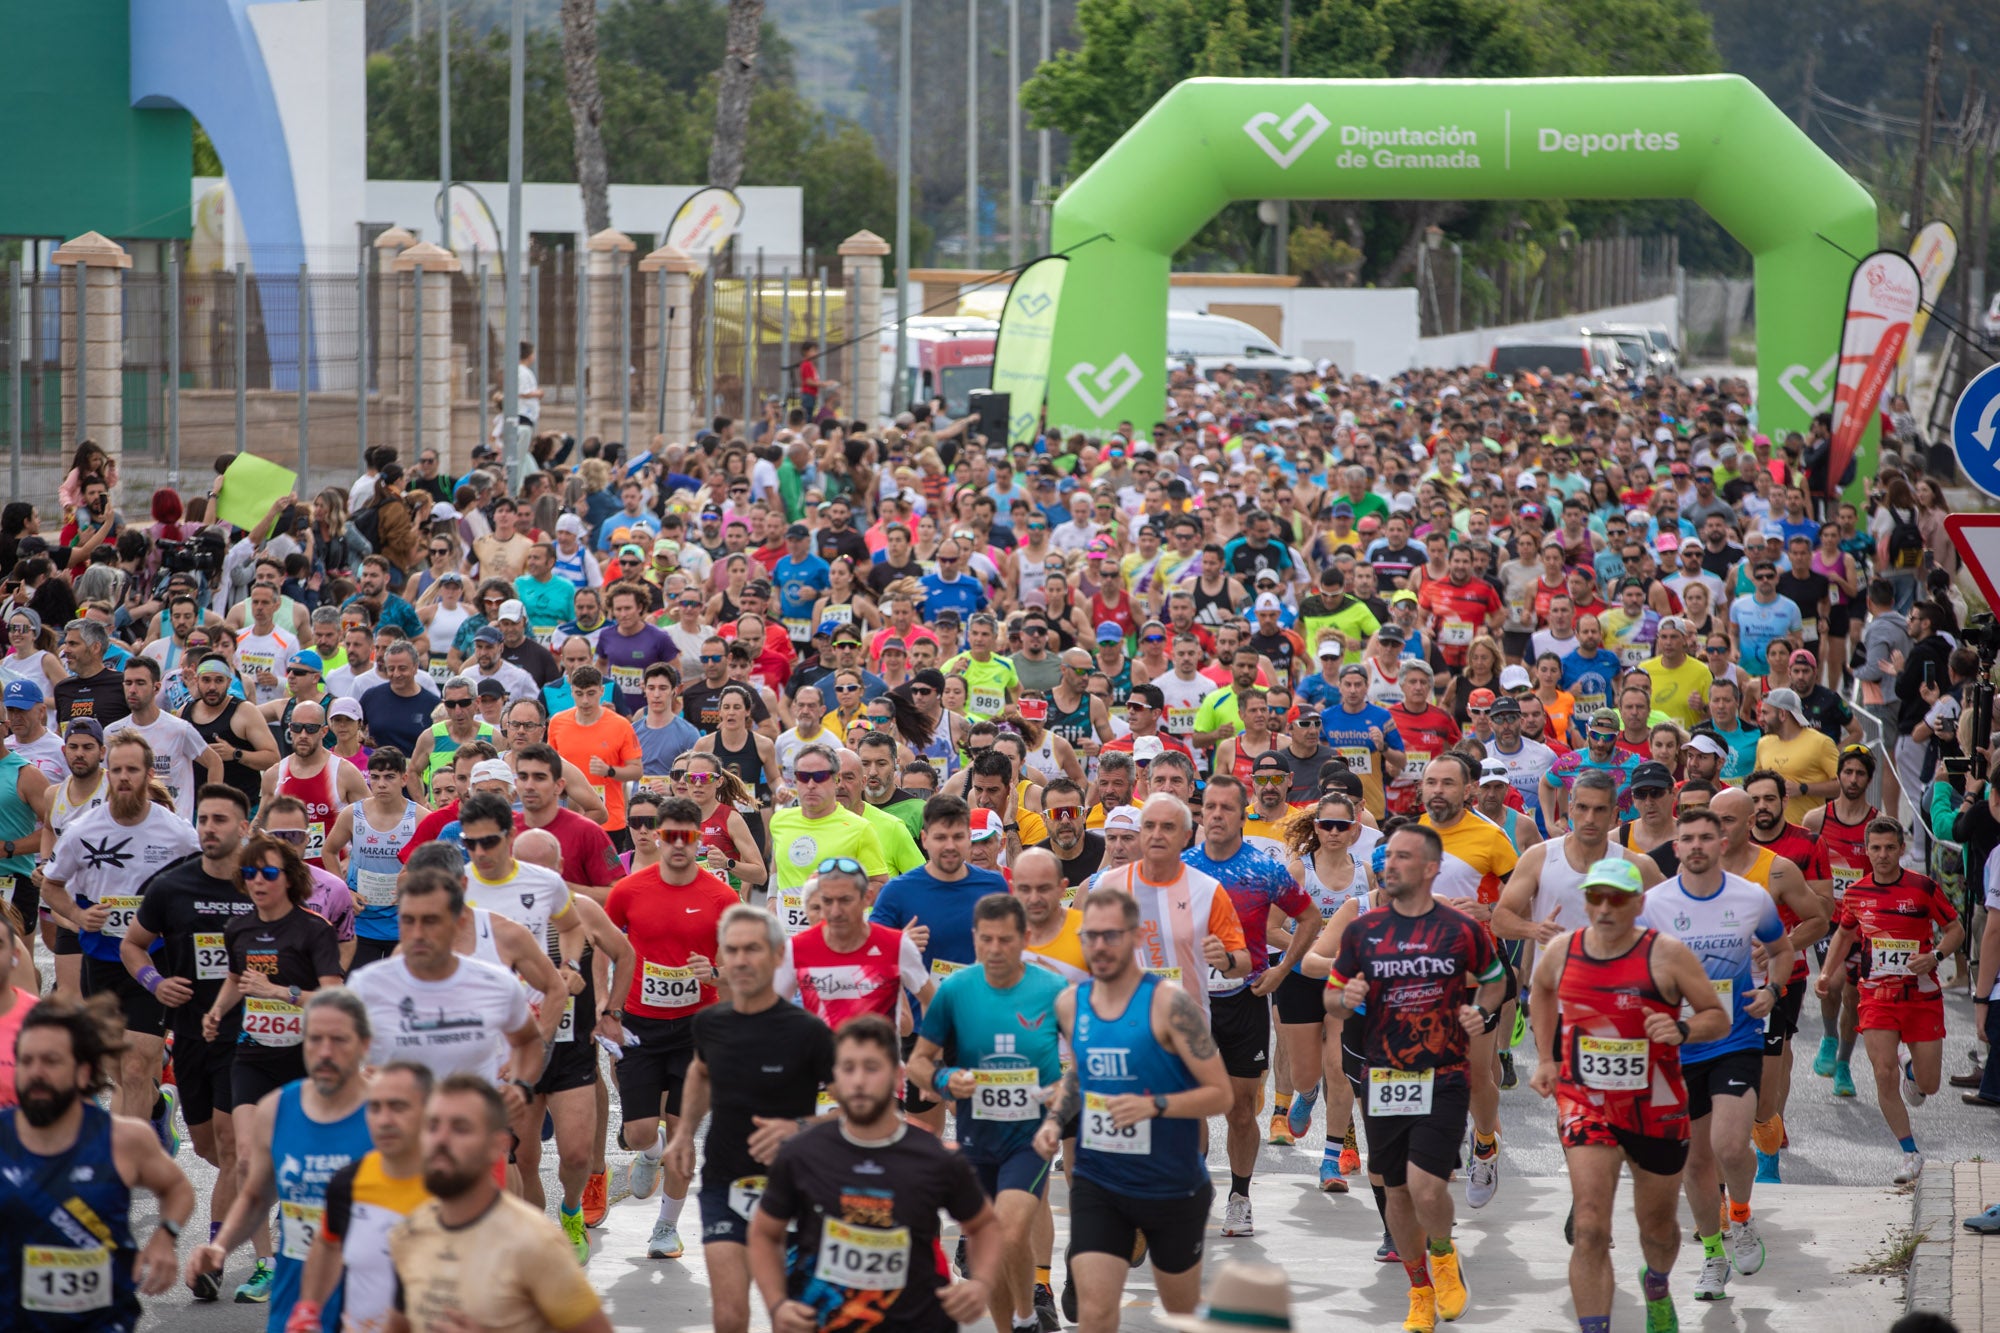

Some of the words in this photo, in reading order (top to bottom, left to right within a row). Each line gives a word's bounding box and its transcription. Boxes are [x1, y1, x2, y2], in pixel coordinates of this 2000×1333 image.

[1341, 126, 1477, 149] Diputación
[1538, 127, 1681, 157] Deportes
[1336, 150, 1368, 168] de
[1373, 149, 1482, 168] Granada
[976, 696, 1000, 709] 989
[70, 708, 94, 717] 2025
[1328, 730, 1369, 742] agustino
[1403, 761, 1425, 773] 27
[193, 901, 230, 912] BLACK
[232, 902, 255, 912] BOX
[109, 910, 135, 928] 36
[787, 910, 810, 926] 52
[1686, 937, 1743, 952] ARACENA
[247, 954, 279, 963] FONDO
[1371, 955, 1455, 978] PIRATAS
[1878, 951, 1911, 966] 147
[644, 977, 698, 997] 3304
[245, 1014, 301, 1035] 2264
[1582, 1053, 1646, 1077] 3335
[982, 1087, 1028, 1108] 683
[1379, 1083, 1423, 1103] 892
[827, 1243, 904, 1275] 1026
[40, 1269, 100, 1297] 139
